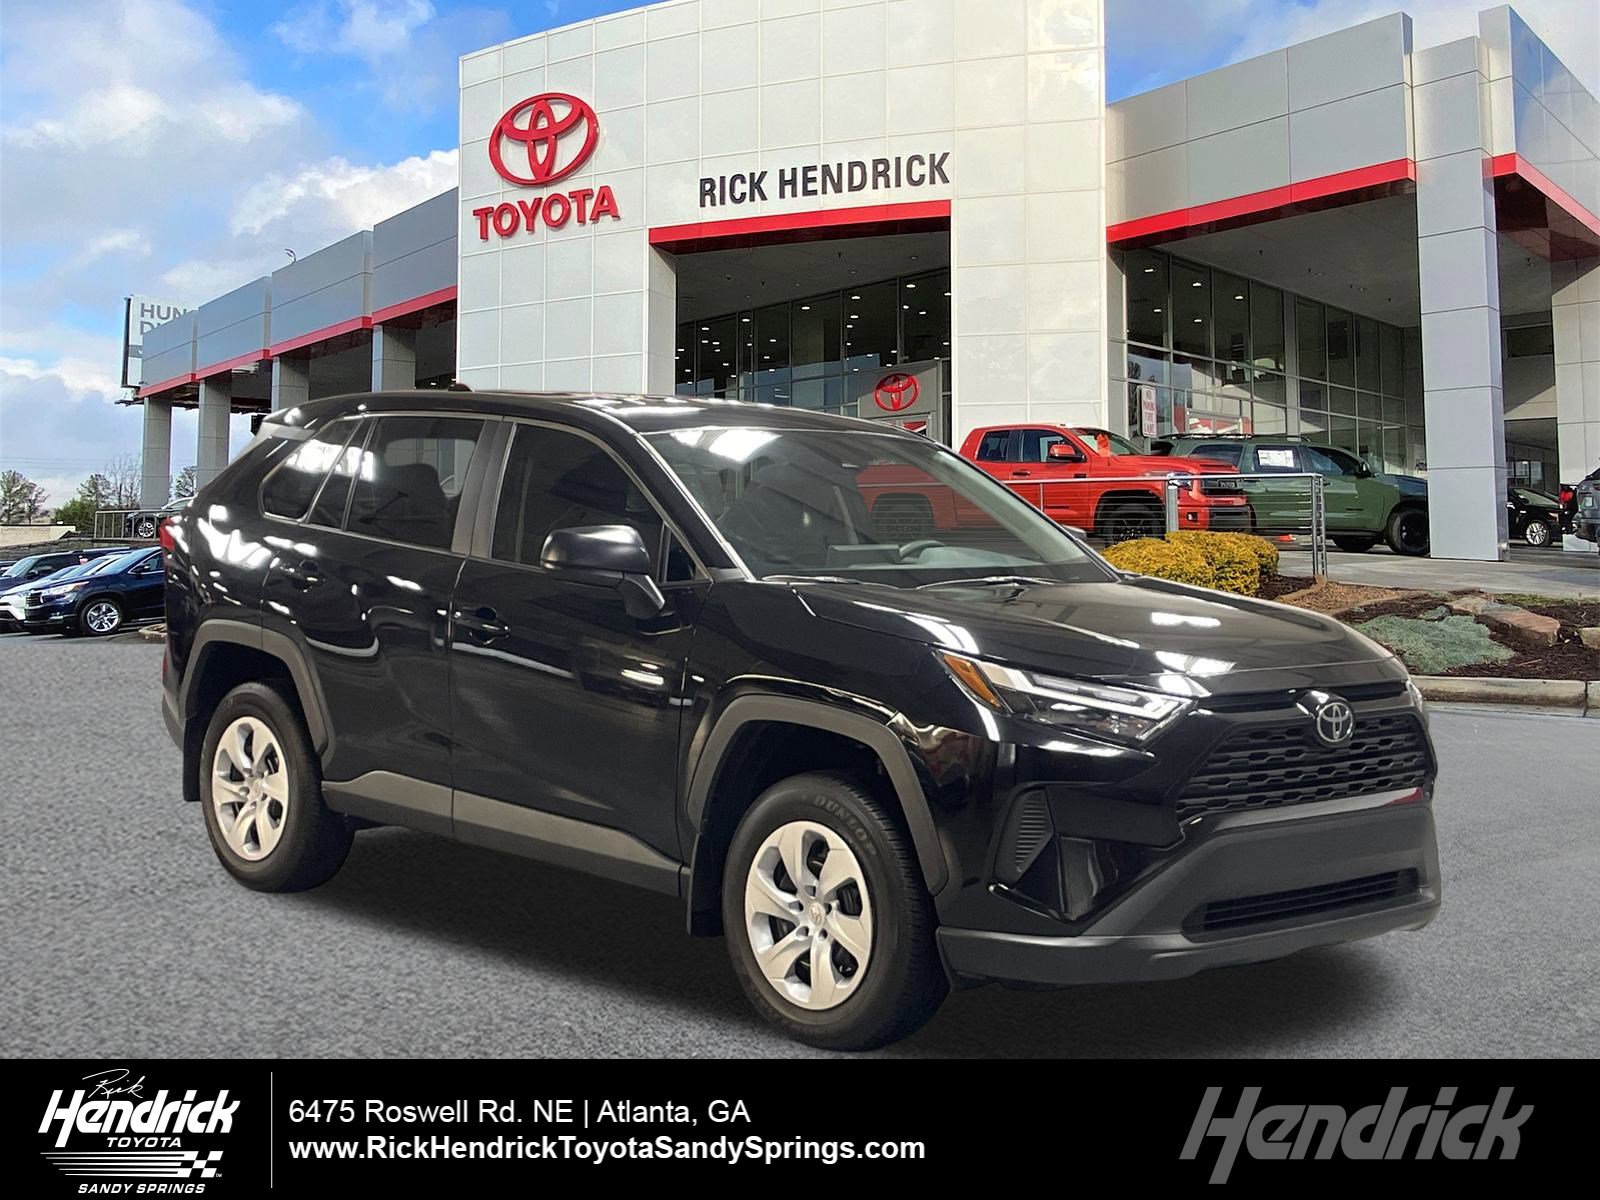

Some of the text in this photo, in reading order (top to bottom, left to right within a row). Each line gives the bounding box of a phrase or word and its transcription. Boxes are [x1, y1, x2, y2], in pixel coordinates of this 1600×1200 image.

[699, 152, 950, 207] RICK HENDRICK
[473, 185, 620, 240] TOYOTA
